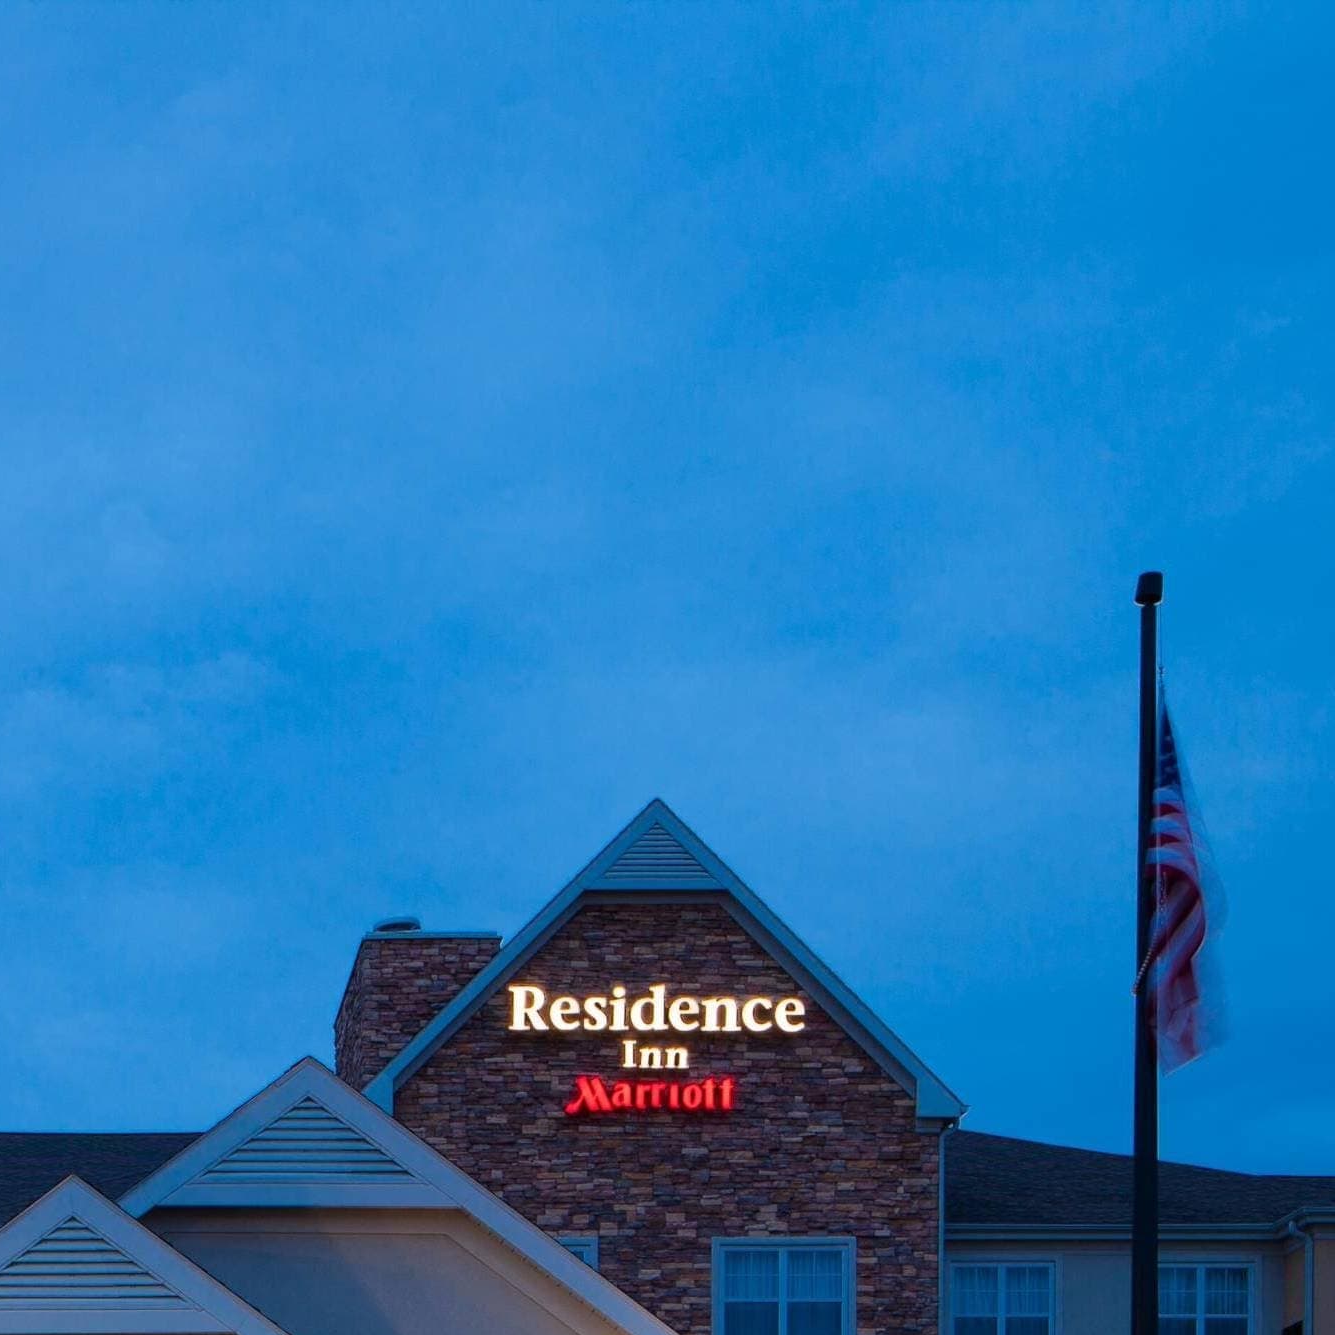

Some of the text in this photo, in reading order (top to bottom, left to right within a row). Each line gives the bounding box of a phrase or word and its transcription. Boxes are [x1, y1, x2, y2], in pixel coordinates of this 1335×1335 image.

[507, 984, 805, 1032] Residence
[622, 1039, 689, 1069] Inn
[565, 1074, 735, 1114] Marriott
